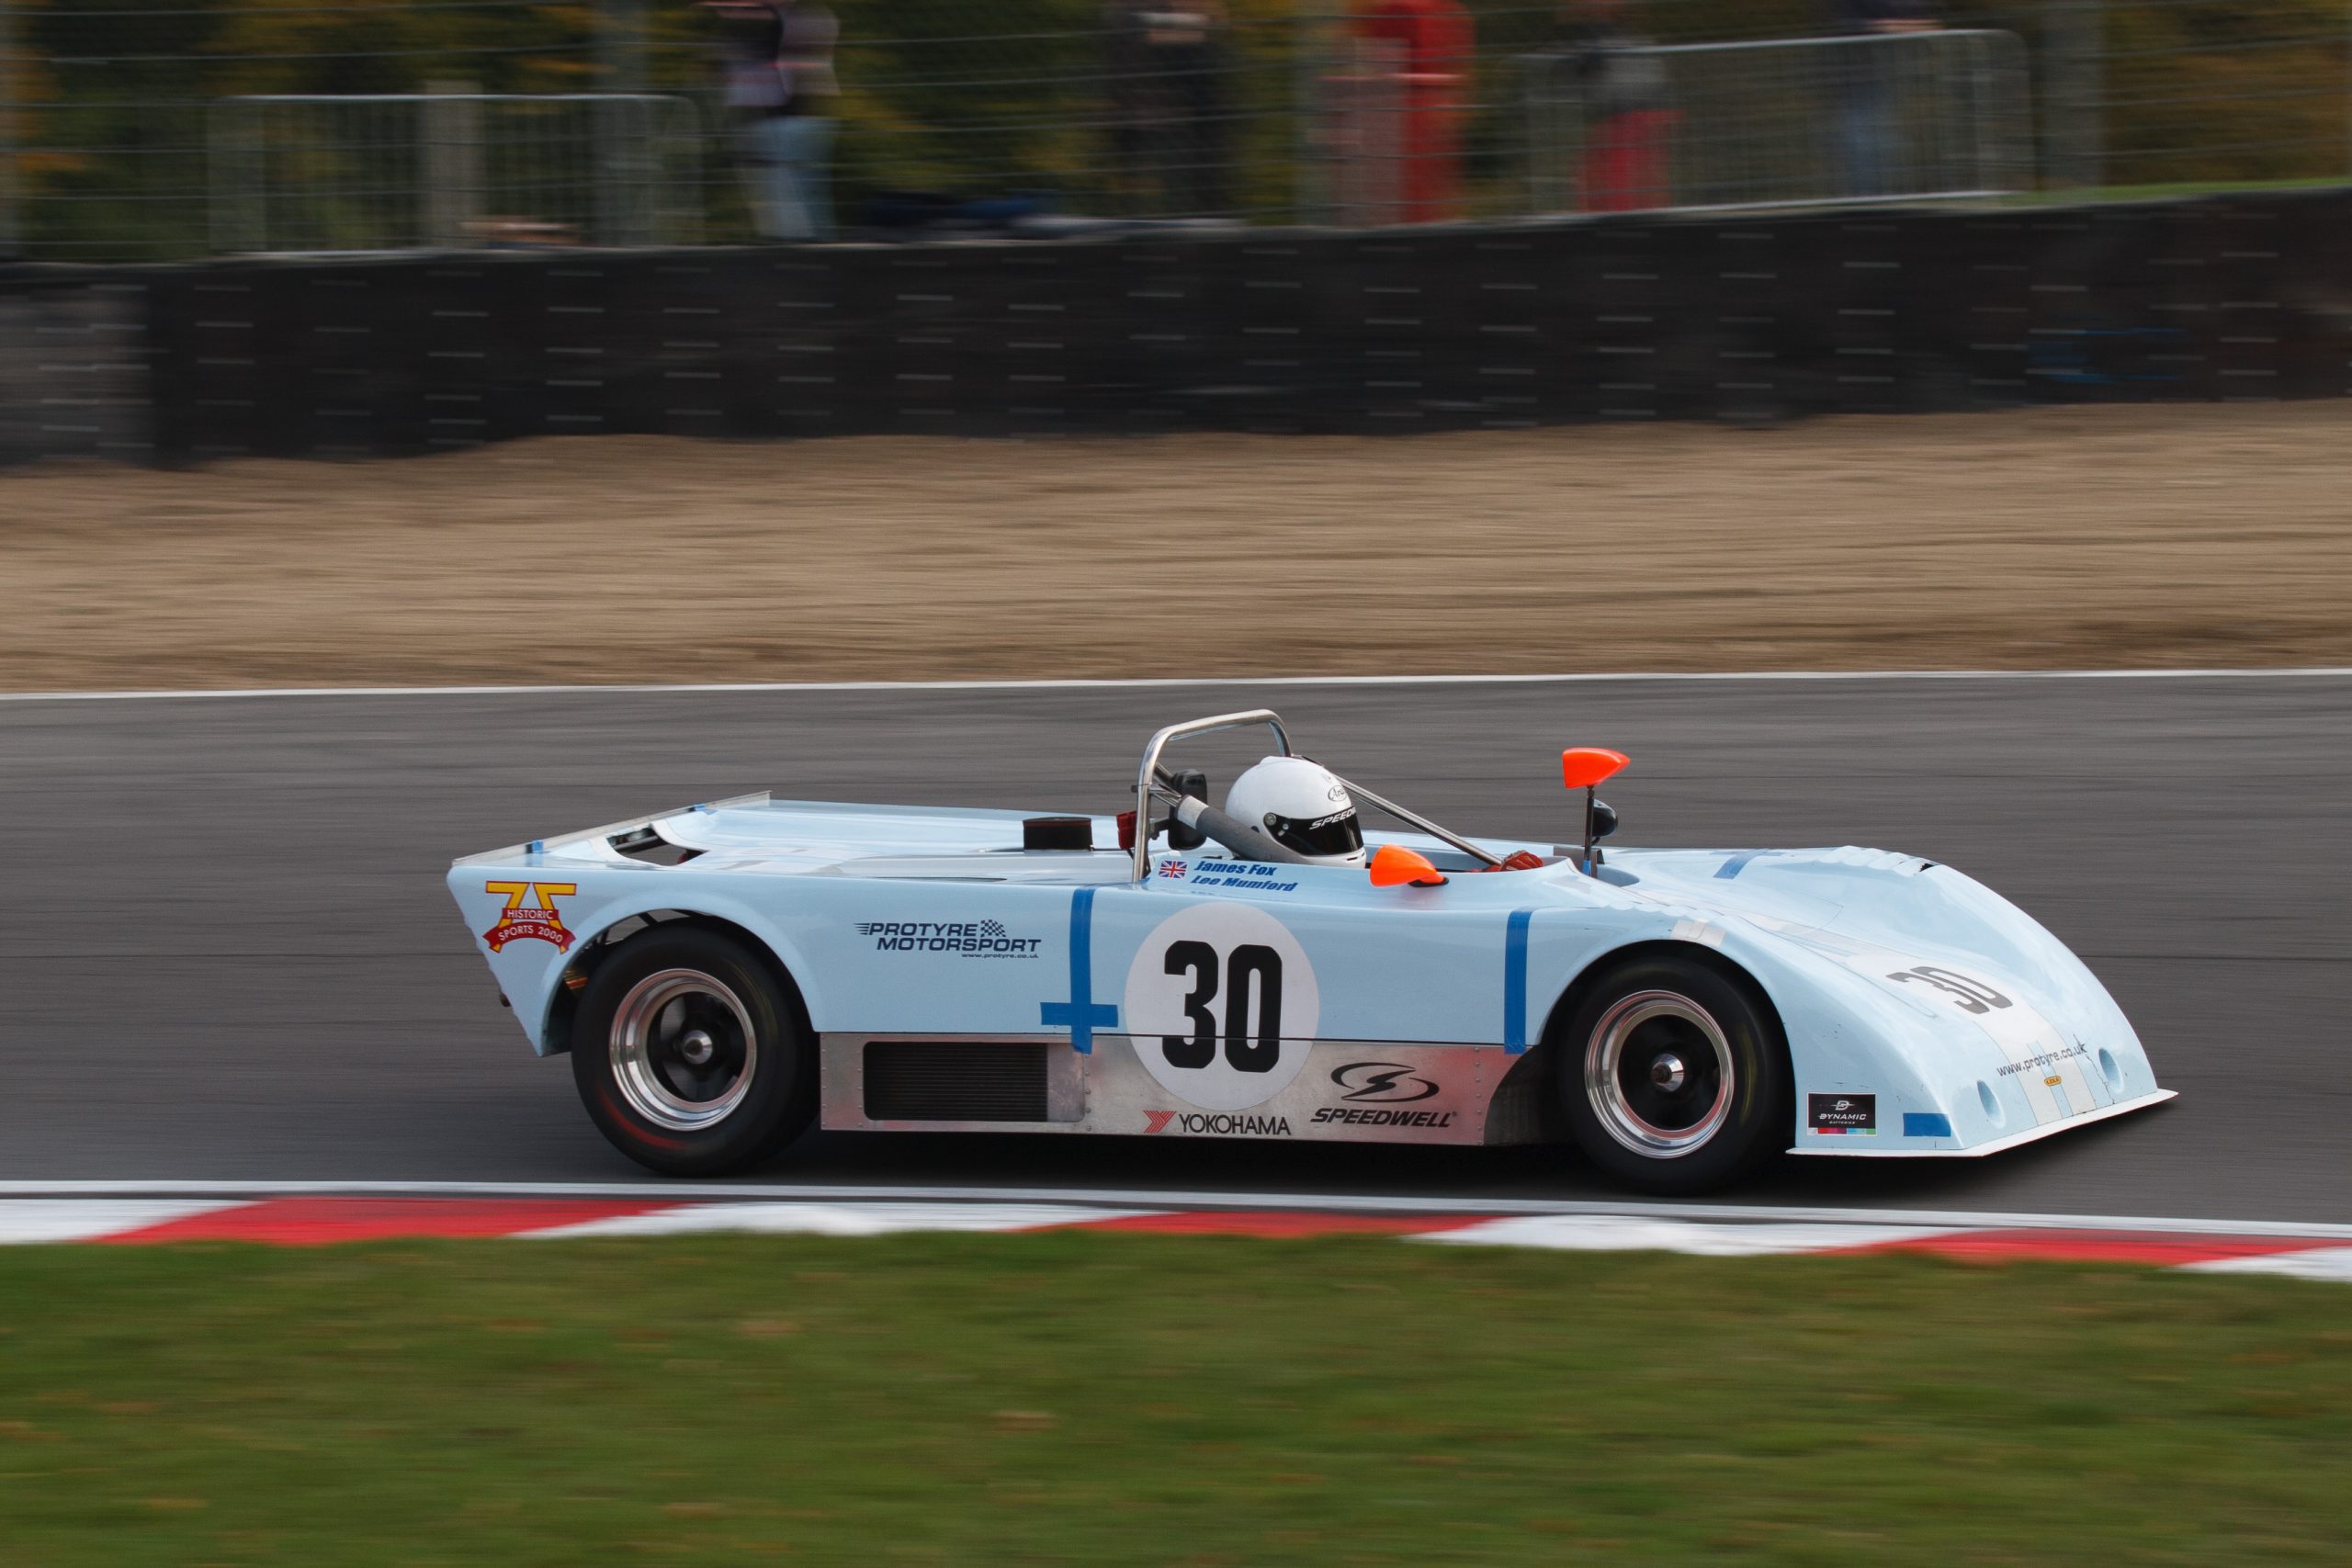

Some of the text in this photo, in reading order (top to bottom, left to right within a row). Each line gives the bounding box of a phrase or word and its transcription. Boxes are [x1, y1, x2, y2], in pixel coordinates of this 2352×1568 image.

[1194, 860, 1277, 876] James Fox
[1191, 874, 1298, 892] Lee Mumford
[507, 909, 553, 919] HISTORIC
[498, 925, 563, 943] SPORTS 2000
[868, 922, 978, 937] PROTYRE
[876, 937, 1042, 952] MOTORSPORT
[1885, 965, 2014, 1015] 30
[1162, 940, 1283, 1073] 30
[1996, 1043, 2087, 1077] www.protyre.co.uk
[1179, 1113, 1292, 1135] YOKOHAMA
[1310, 1108, 1452, 1128] SPEEDWELL
